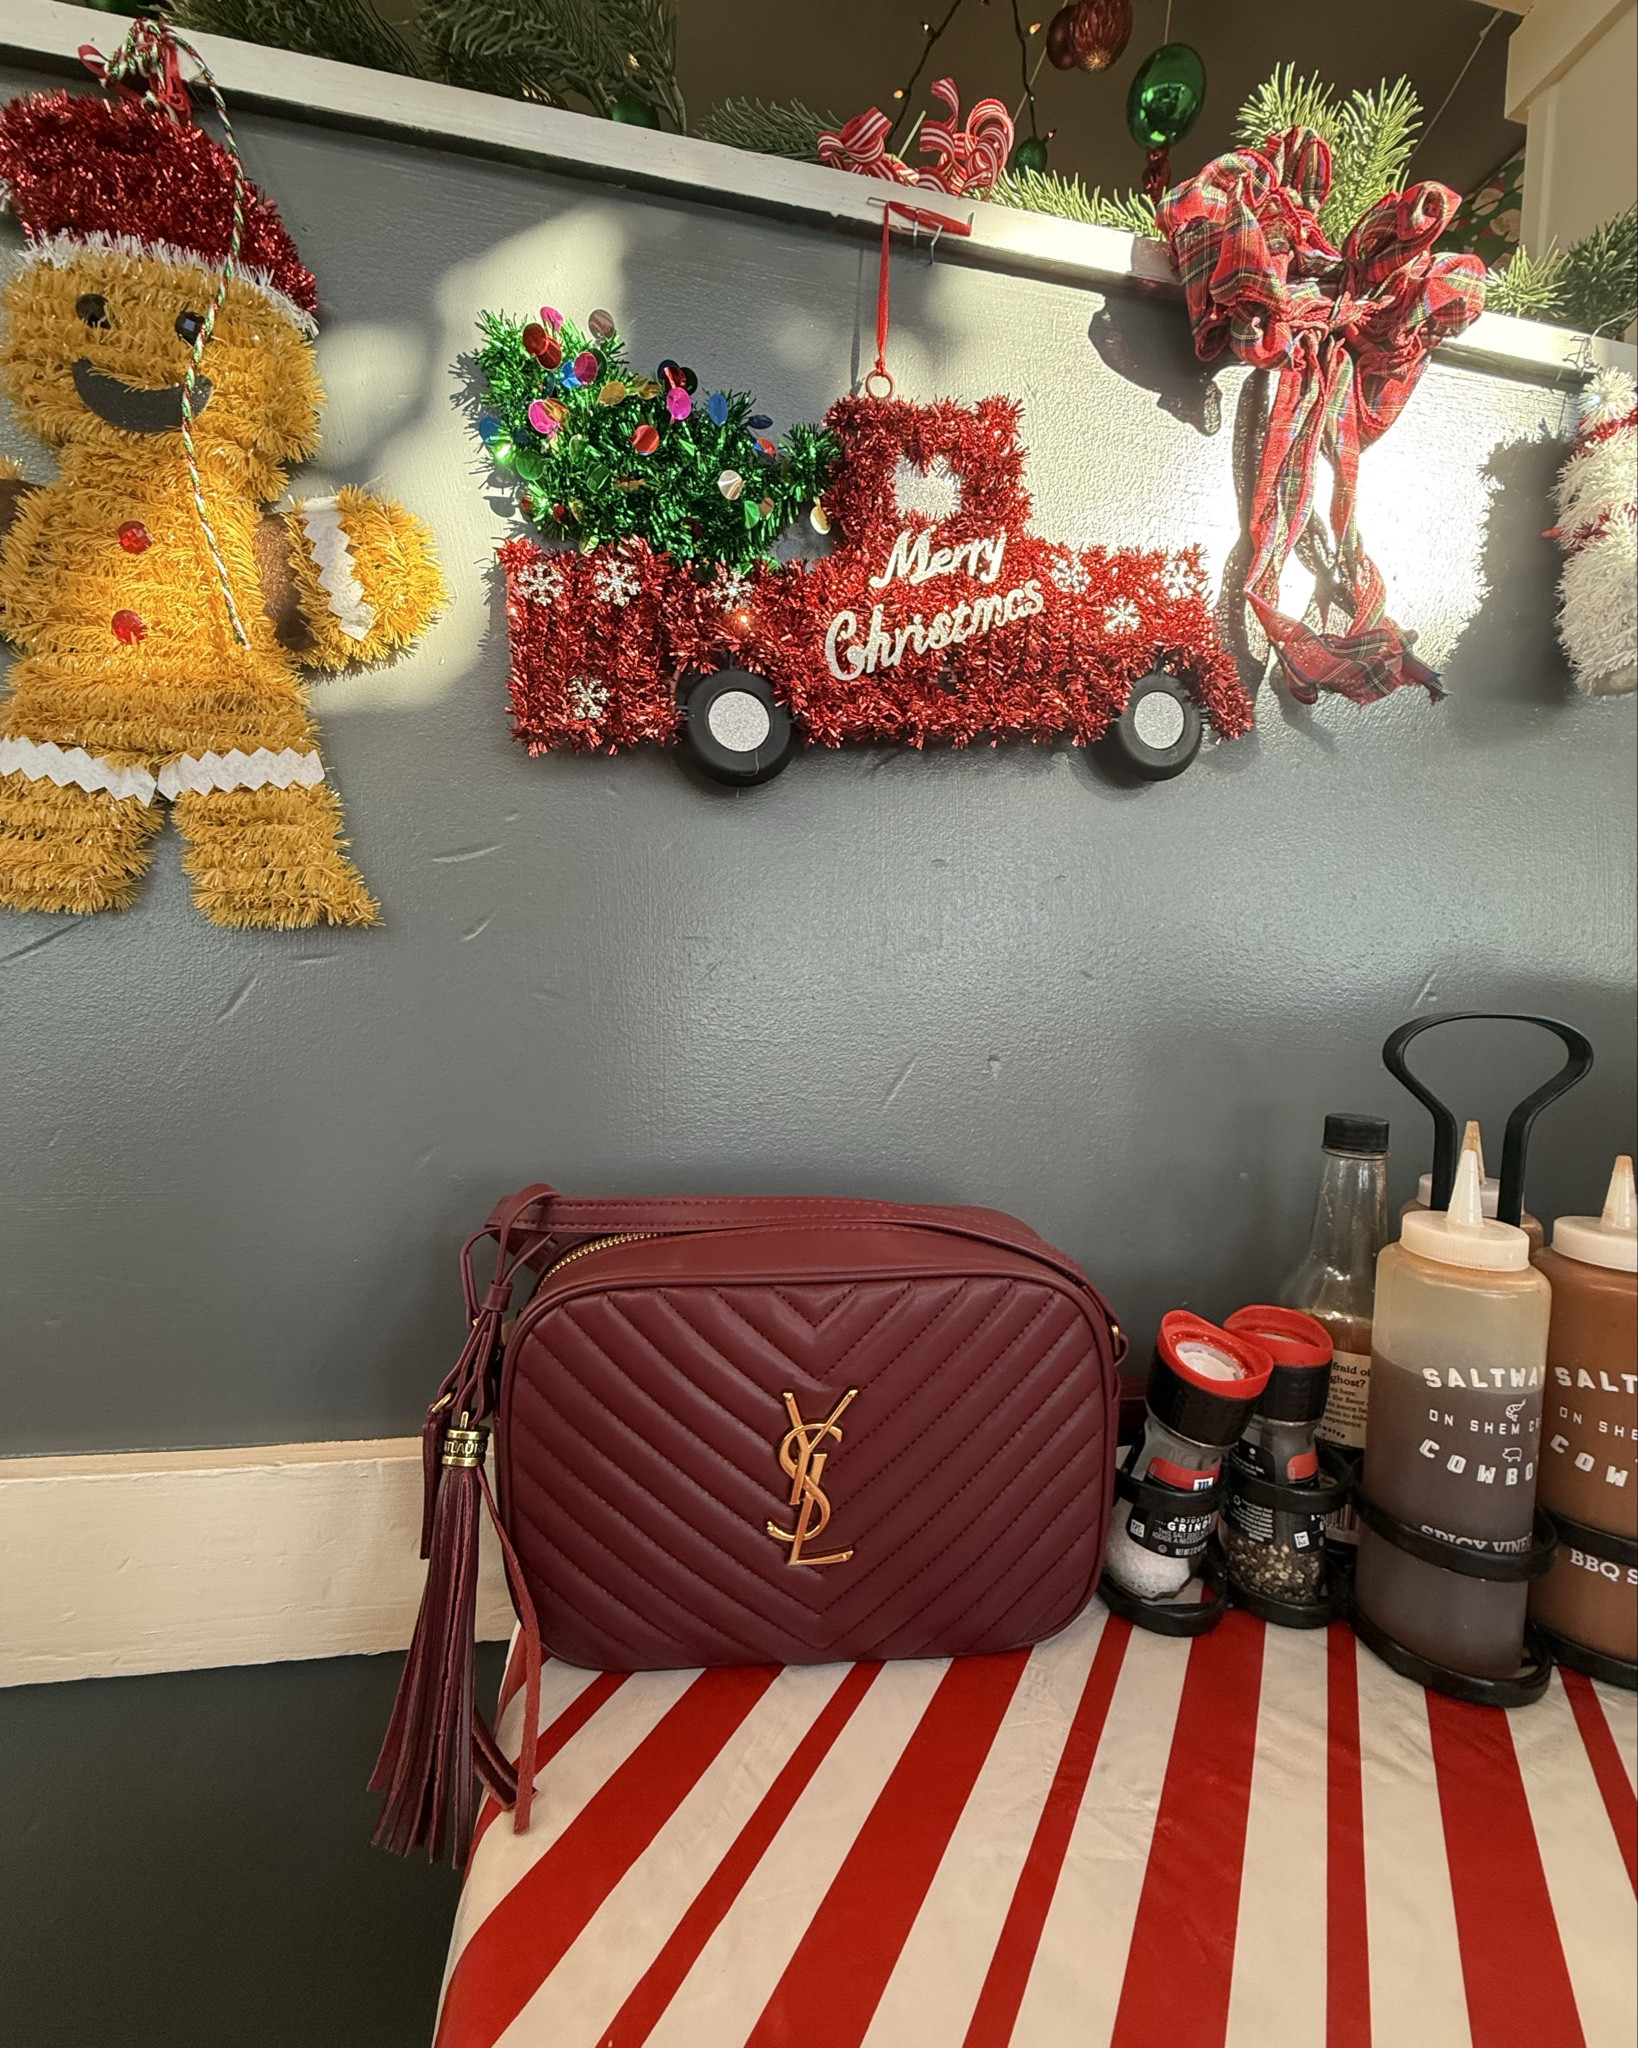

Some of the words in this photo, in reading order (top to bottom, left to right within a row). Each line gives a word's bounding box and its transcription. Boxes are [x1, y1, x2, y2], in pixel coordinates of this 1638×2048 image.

[869, 524, 1008, 589] Merry
[825, 579, 1044, 681] Christmas
[1554, 1366, 1637, 1394] SALT
[1429, 1409, 1454, 1427] ON
[1469, 1420, 1520, 1435] SHEM
[1559, 1406, 1582, 1425] ON
[767, 1389, 858, 1566] YSL
[1419, 1438, 1533, 1486] COWBO
[1550, 1434, 1629, 1487] COW
[1570, 1548, 1620, 1582] BBQ
